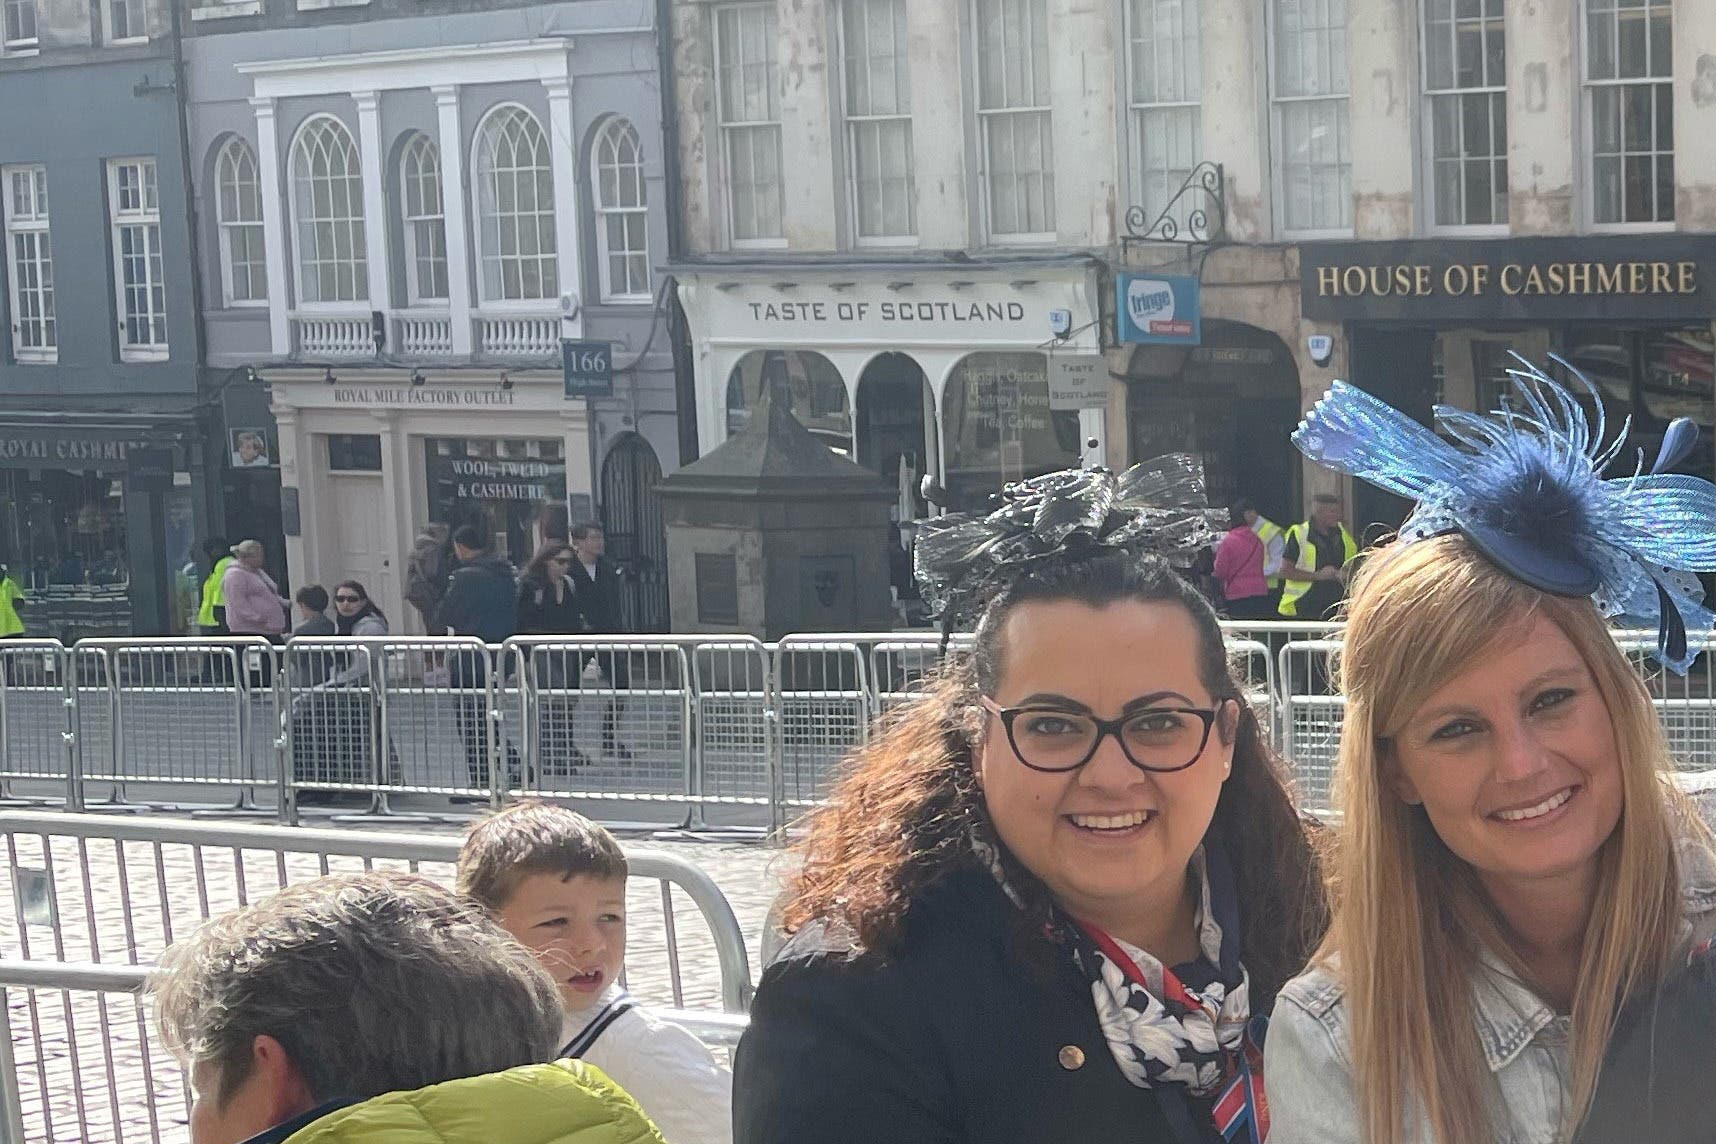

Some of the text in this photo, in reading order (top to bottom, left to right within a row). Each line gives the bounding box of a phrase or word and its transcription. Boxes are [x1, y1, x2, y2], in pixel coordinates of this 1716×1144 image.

[1316, 262, 1697, 296] HOUSE OF CASHMERE
[749, 303, 1024, 320] TASTE OF SCOTLAND
[1131, 290, 1170, 315] fringe
[571, 351, 606, 373] 166
[408, 390, 460, 404] FACTORY
[464, 390, 514, 405] OUTLET
[451, 460, 496, 478] WOOL,
[457, 483, 546, 499] & CASHMERE
